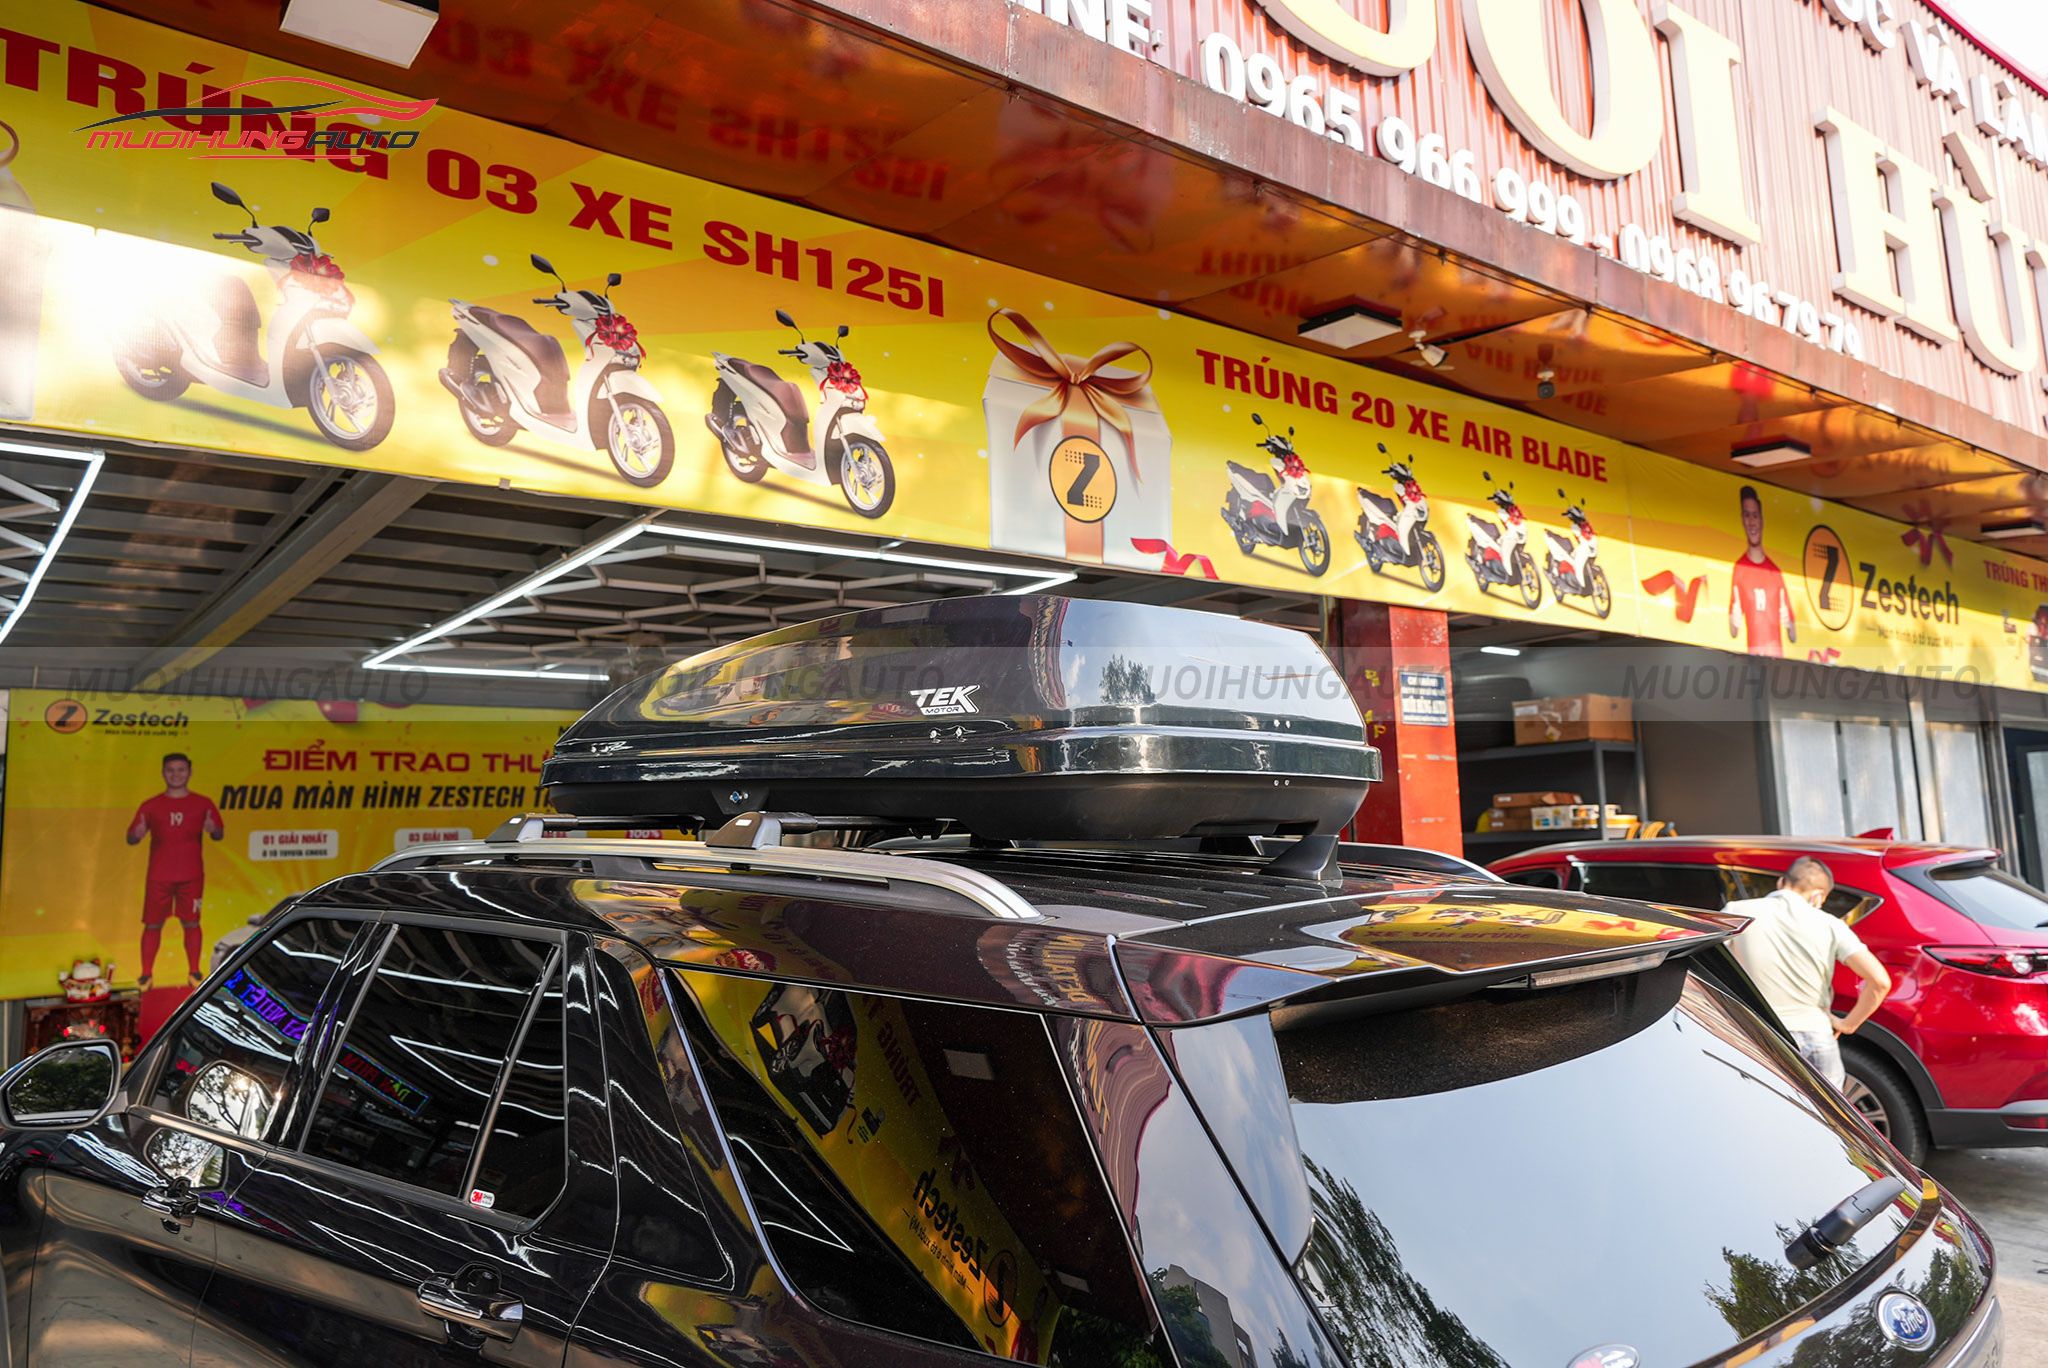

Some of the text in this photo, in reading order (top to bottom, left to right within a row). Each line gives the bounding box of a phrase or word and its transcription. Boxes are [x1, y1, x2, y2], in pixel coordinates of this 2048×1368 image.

[1194, 31, 1365, 151] 0965
[1376, 115, 1482, 204] 966
[1495, 167, 1587, 247] 999
[1618, 222, 1724, 304] 0968
[426, 149, 539, 215] 03
[568, 181, 674, 250] XE
[702, 220, 946, 317] SH125I
[1196, 347, 1609, 483] TRÚNG 20 XE AIR BLADE
[1858, 560, 1961, 625] Zestech
[909, 684, 981, 713] TEK
[924, 706, 960, 714] MOTOR
[92, 707, 189, 729] Zestech
[262, 739, 357, 772] ĐIỂM
[371, 750, 470, 773] TRAO
[218, 784, 285, 810] MUA
[292, 780, 354, 810] MÀN
[361, 780, 422, 809] HÌNH
[427, 785, 526, 809] ZESTECH
[169, 811, 184, 827] 19
